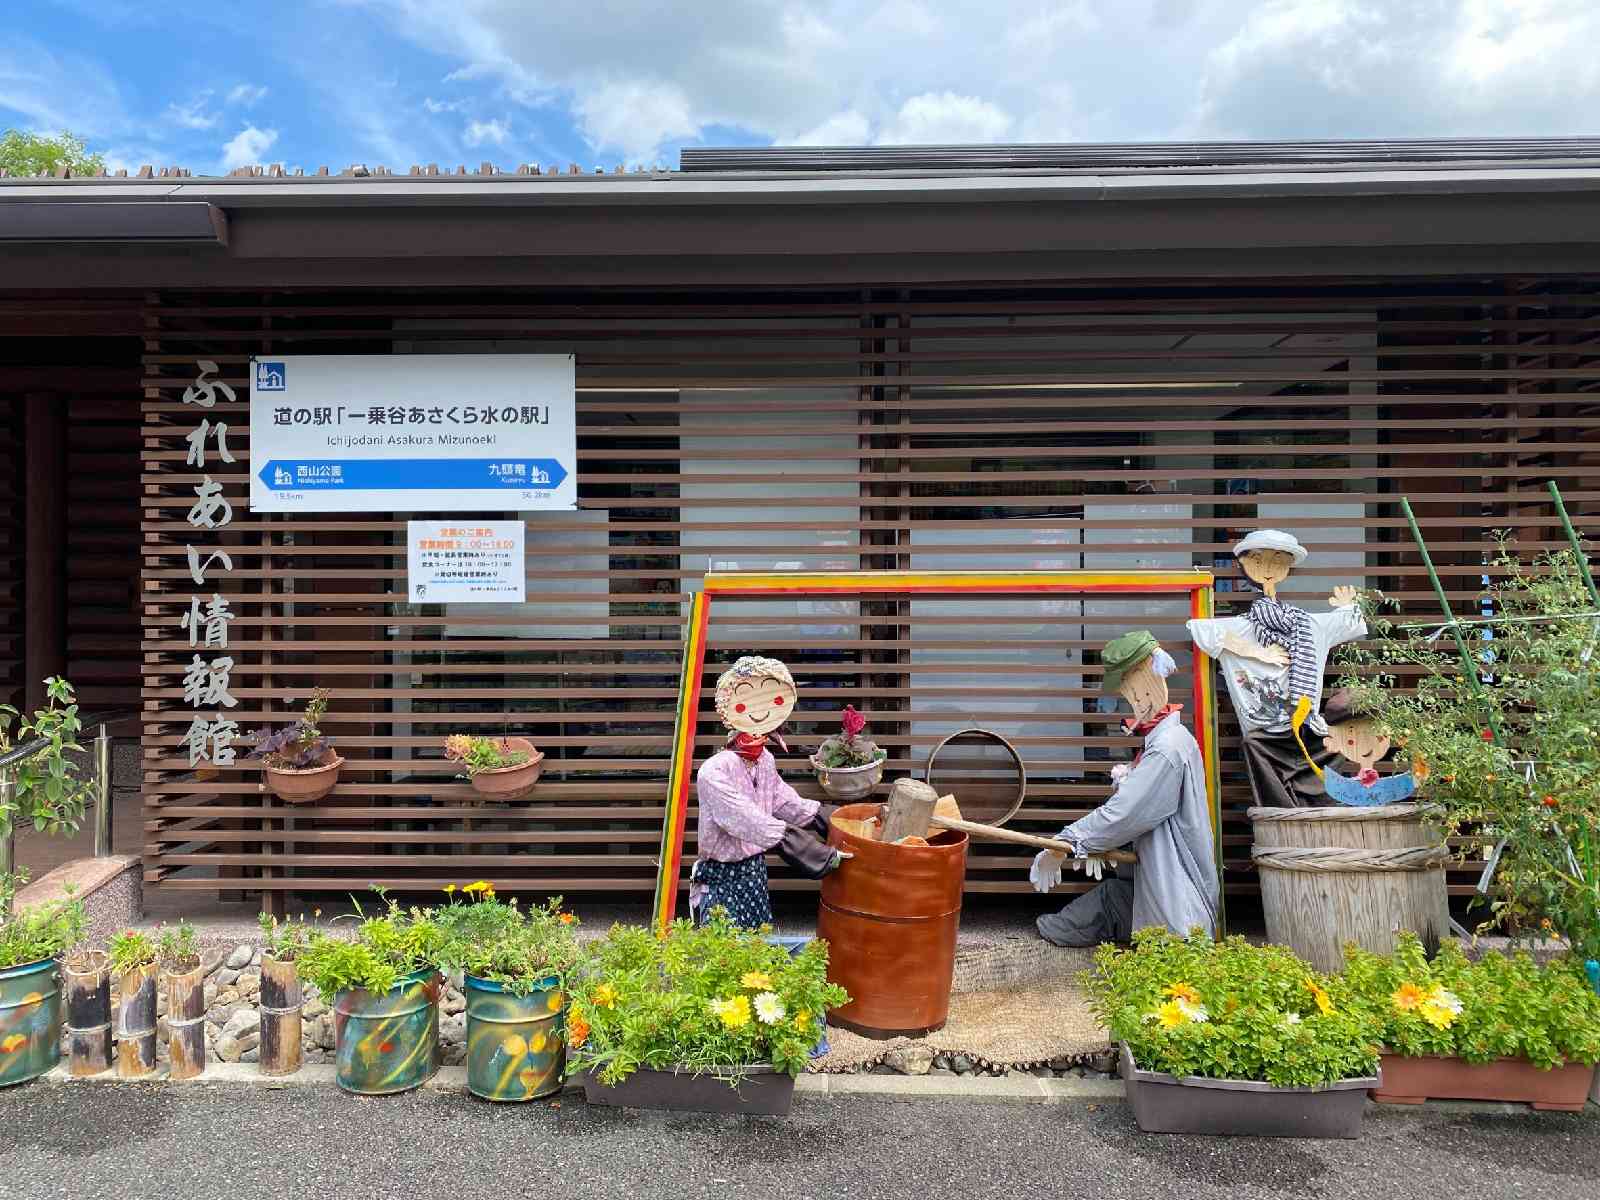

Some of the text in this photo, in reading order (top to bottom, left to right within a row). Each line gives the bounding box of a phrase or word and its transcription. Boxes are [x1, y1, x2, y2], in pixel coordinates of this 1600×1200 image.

[273, 406, 550, 426] 道の駅「一乗谷あさくら水の駅」
[327, 434, 497, 447] Ichijodani Asakura Mizunoeki
[296, 465, 342, 477] 西山公園
[182, 359, 239, 768] ふれあい情報館
